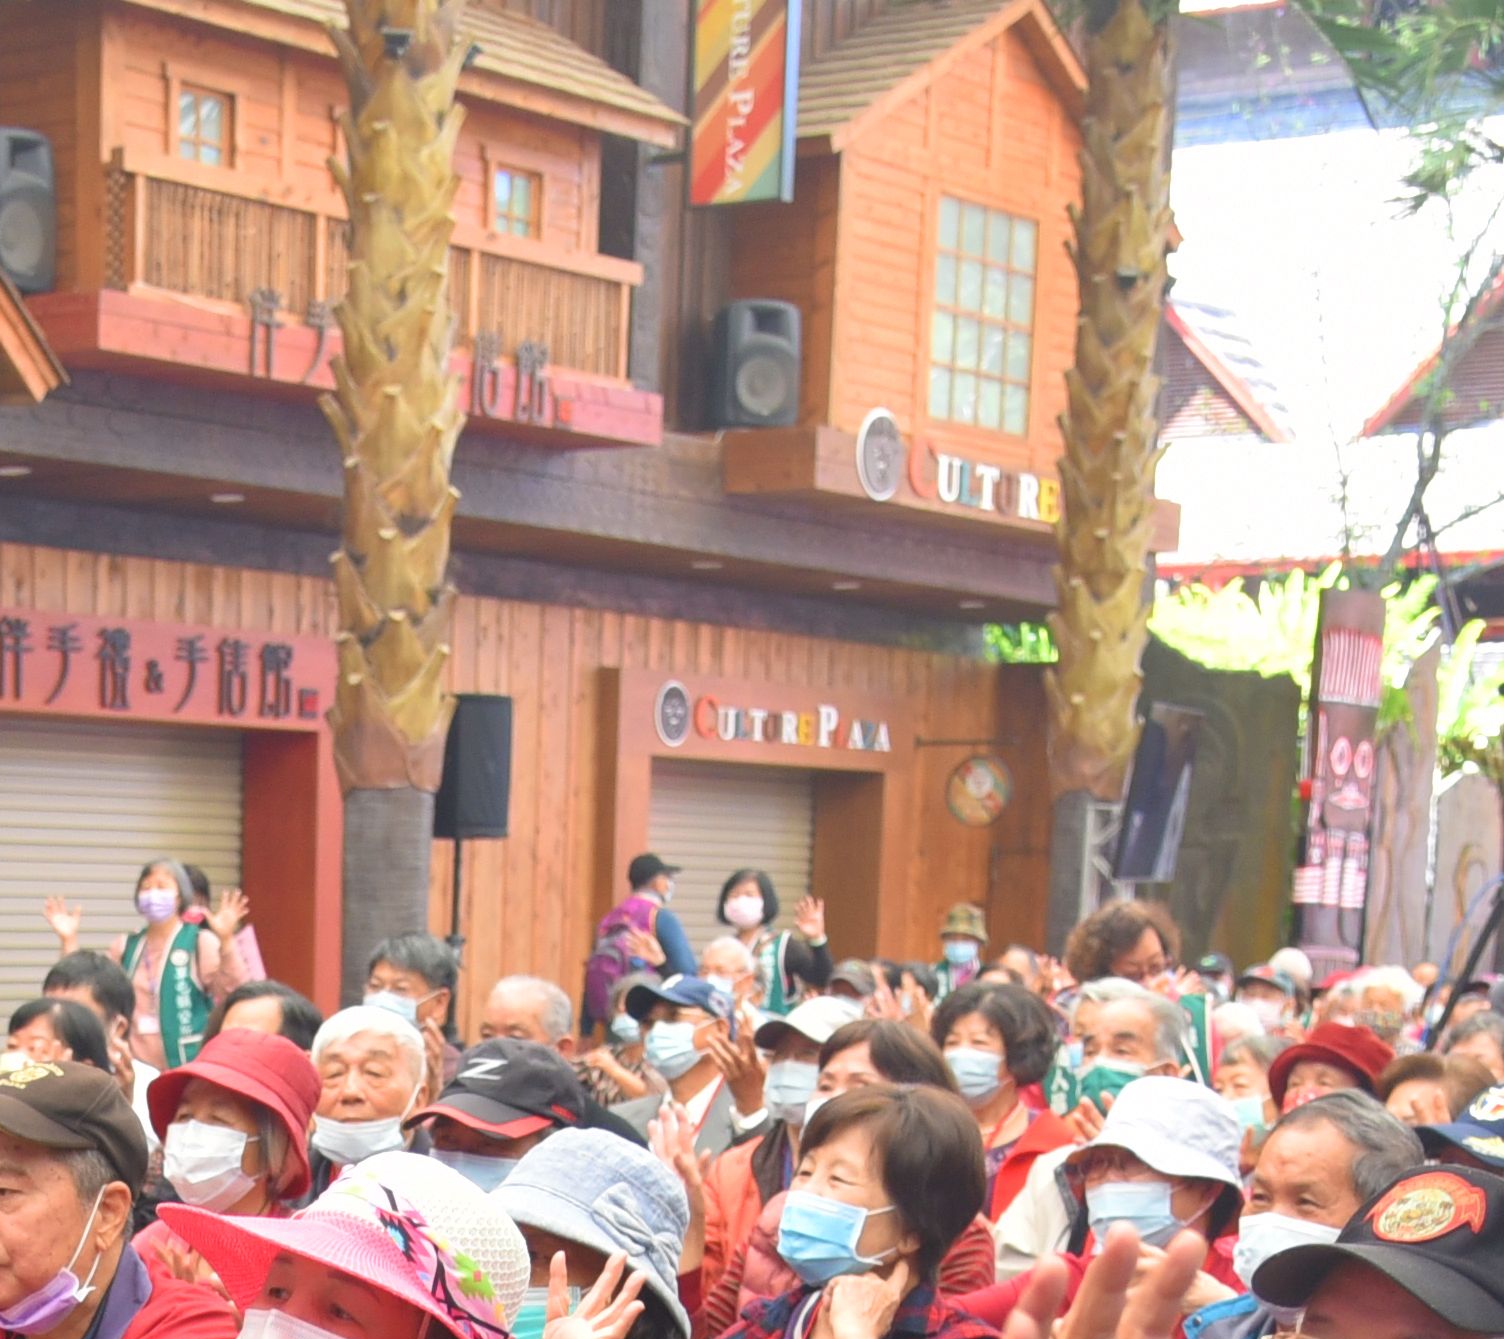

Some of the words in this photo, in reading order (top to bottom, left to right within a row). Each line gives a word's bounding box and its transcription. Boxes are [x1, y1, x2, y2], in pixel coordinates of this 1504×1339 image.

[908, 435, 1061, 524] CULTURE
[693, 694, 815, 747] CULTURE
[816, 703, 892, 753] PLAZA
